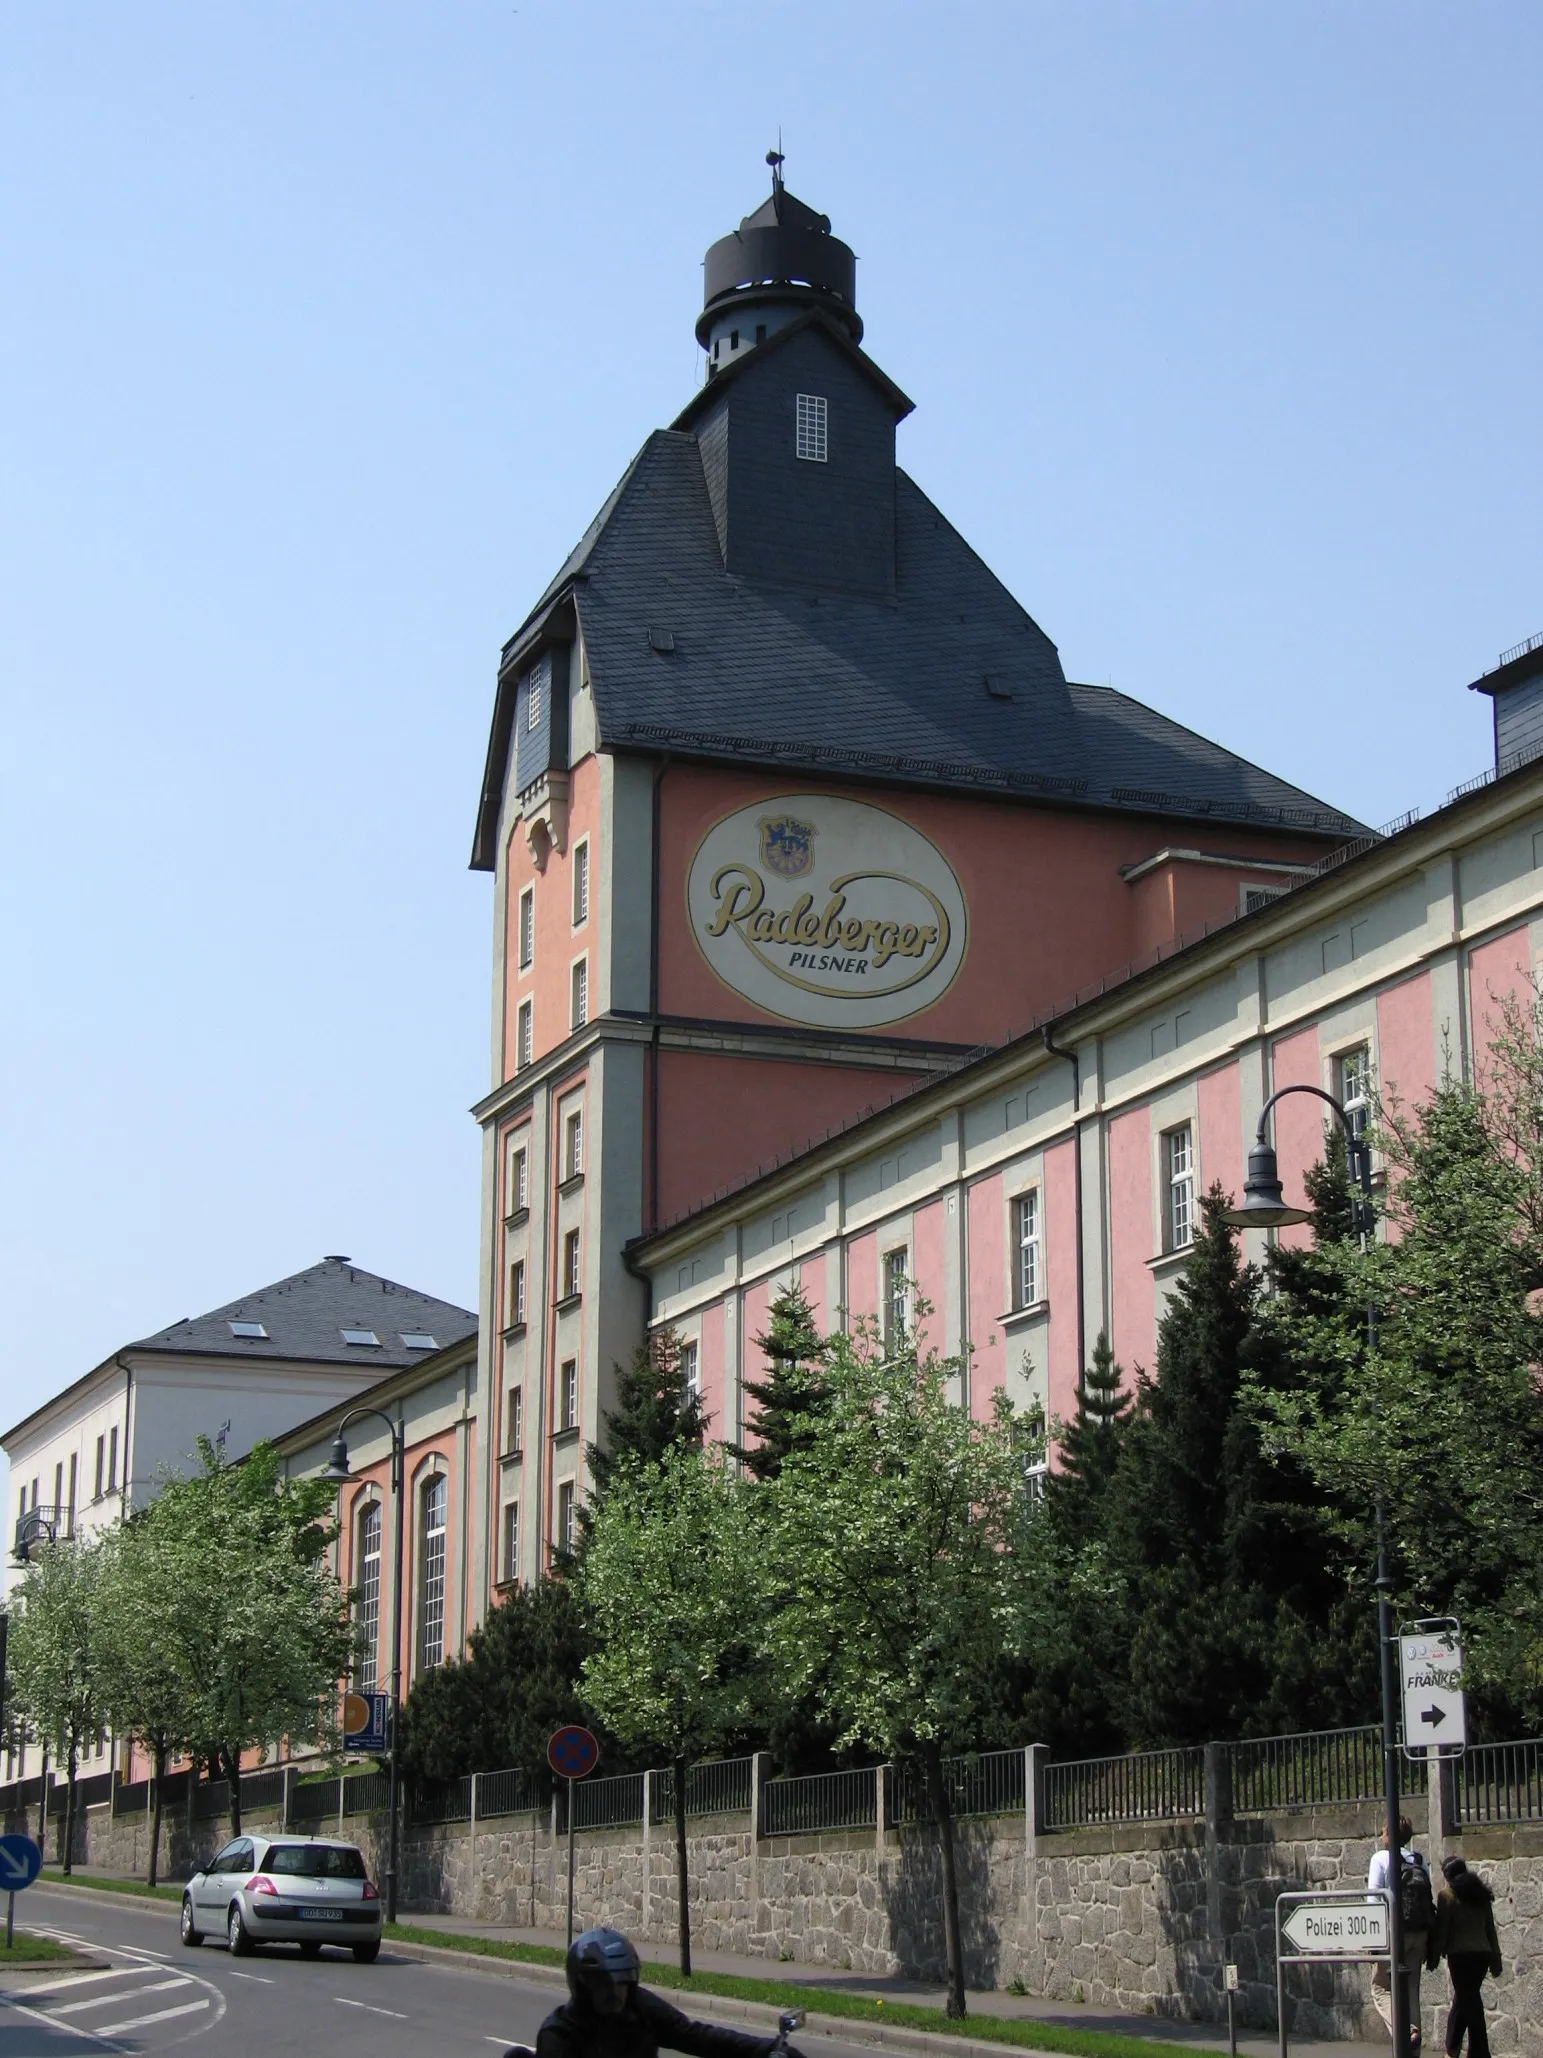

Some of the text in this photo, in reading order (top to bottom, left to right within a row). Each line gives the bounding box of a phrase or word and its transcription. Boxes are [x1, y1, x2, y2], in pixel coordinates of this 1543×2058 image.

[705, 863, 940, 968] Radeberger
[789, 952, 868, 974] PILSNER
[1306, 1916, 1380, 1936] Polizei 300 m
